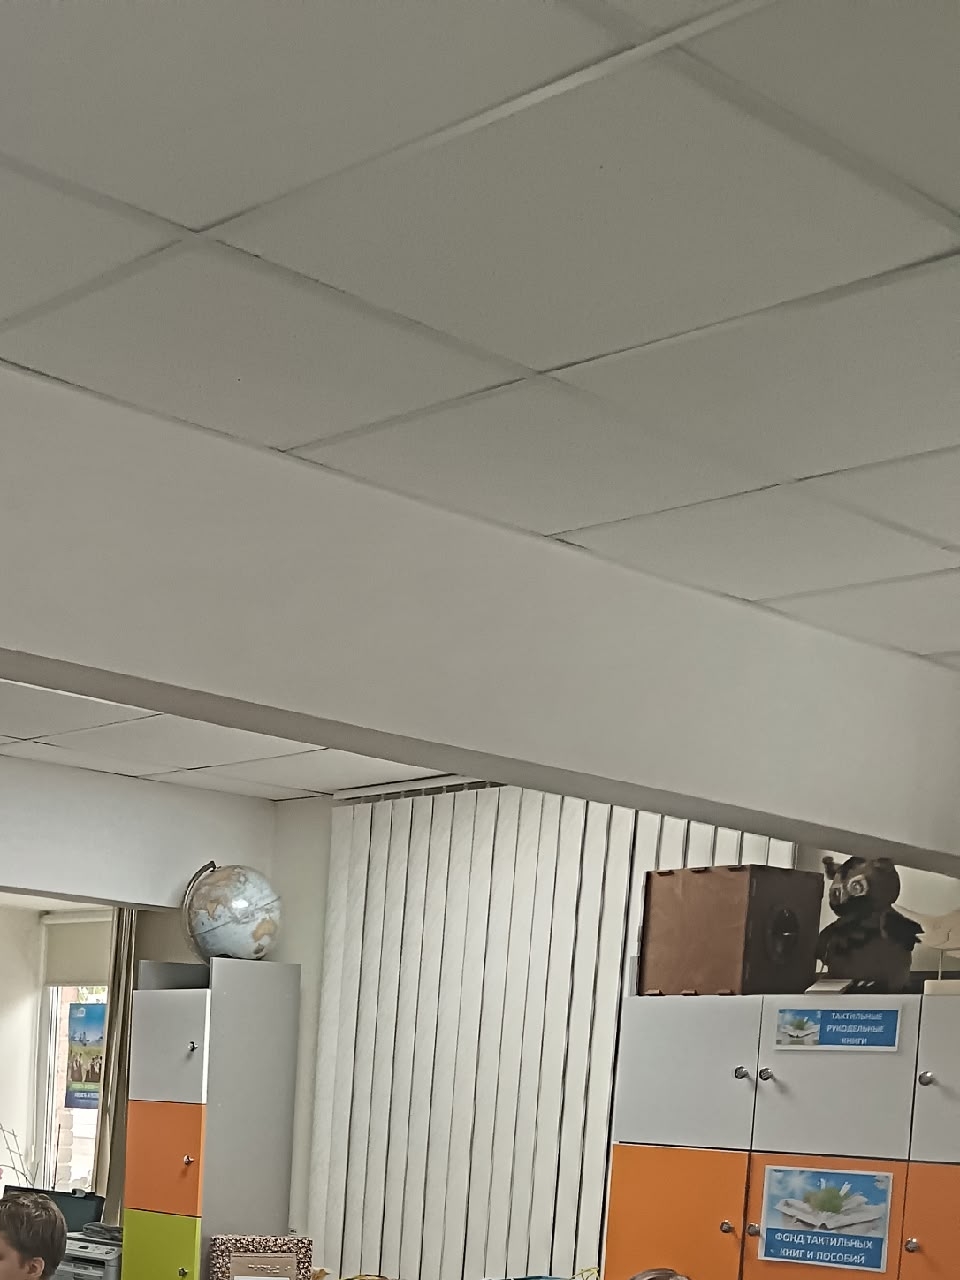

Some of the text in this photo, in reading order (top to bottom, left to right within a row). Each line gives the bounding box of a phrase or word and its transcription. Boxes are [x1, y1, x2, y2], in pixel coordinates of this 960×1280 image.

[831, 1012, 883, 1020] ТАКТИЛЬНЫЕ
[826, 1024, 885, 1033] РУКОДЕЛЬНЫЕ
[775, 1232, 873, 1249] ФОНД ТАКТИЛЬНЫХ
[780, 1247, 805, 1257] КНИГ
[816, 1251, 865, 1264] ПОСОБИЙ
